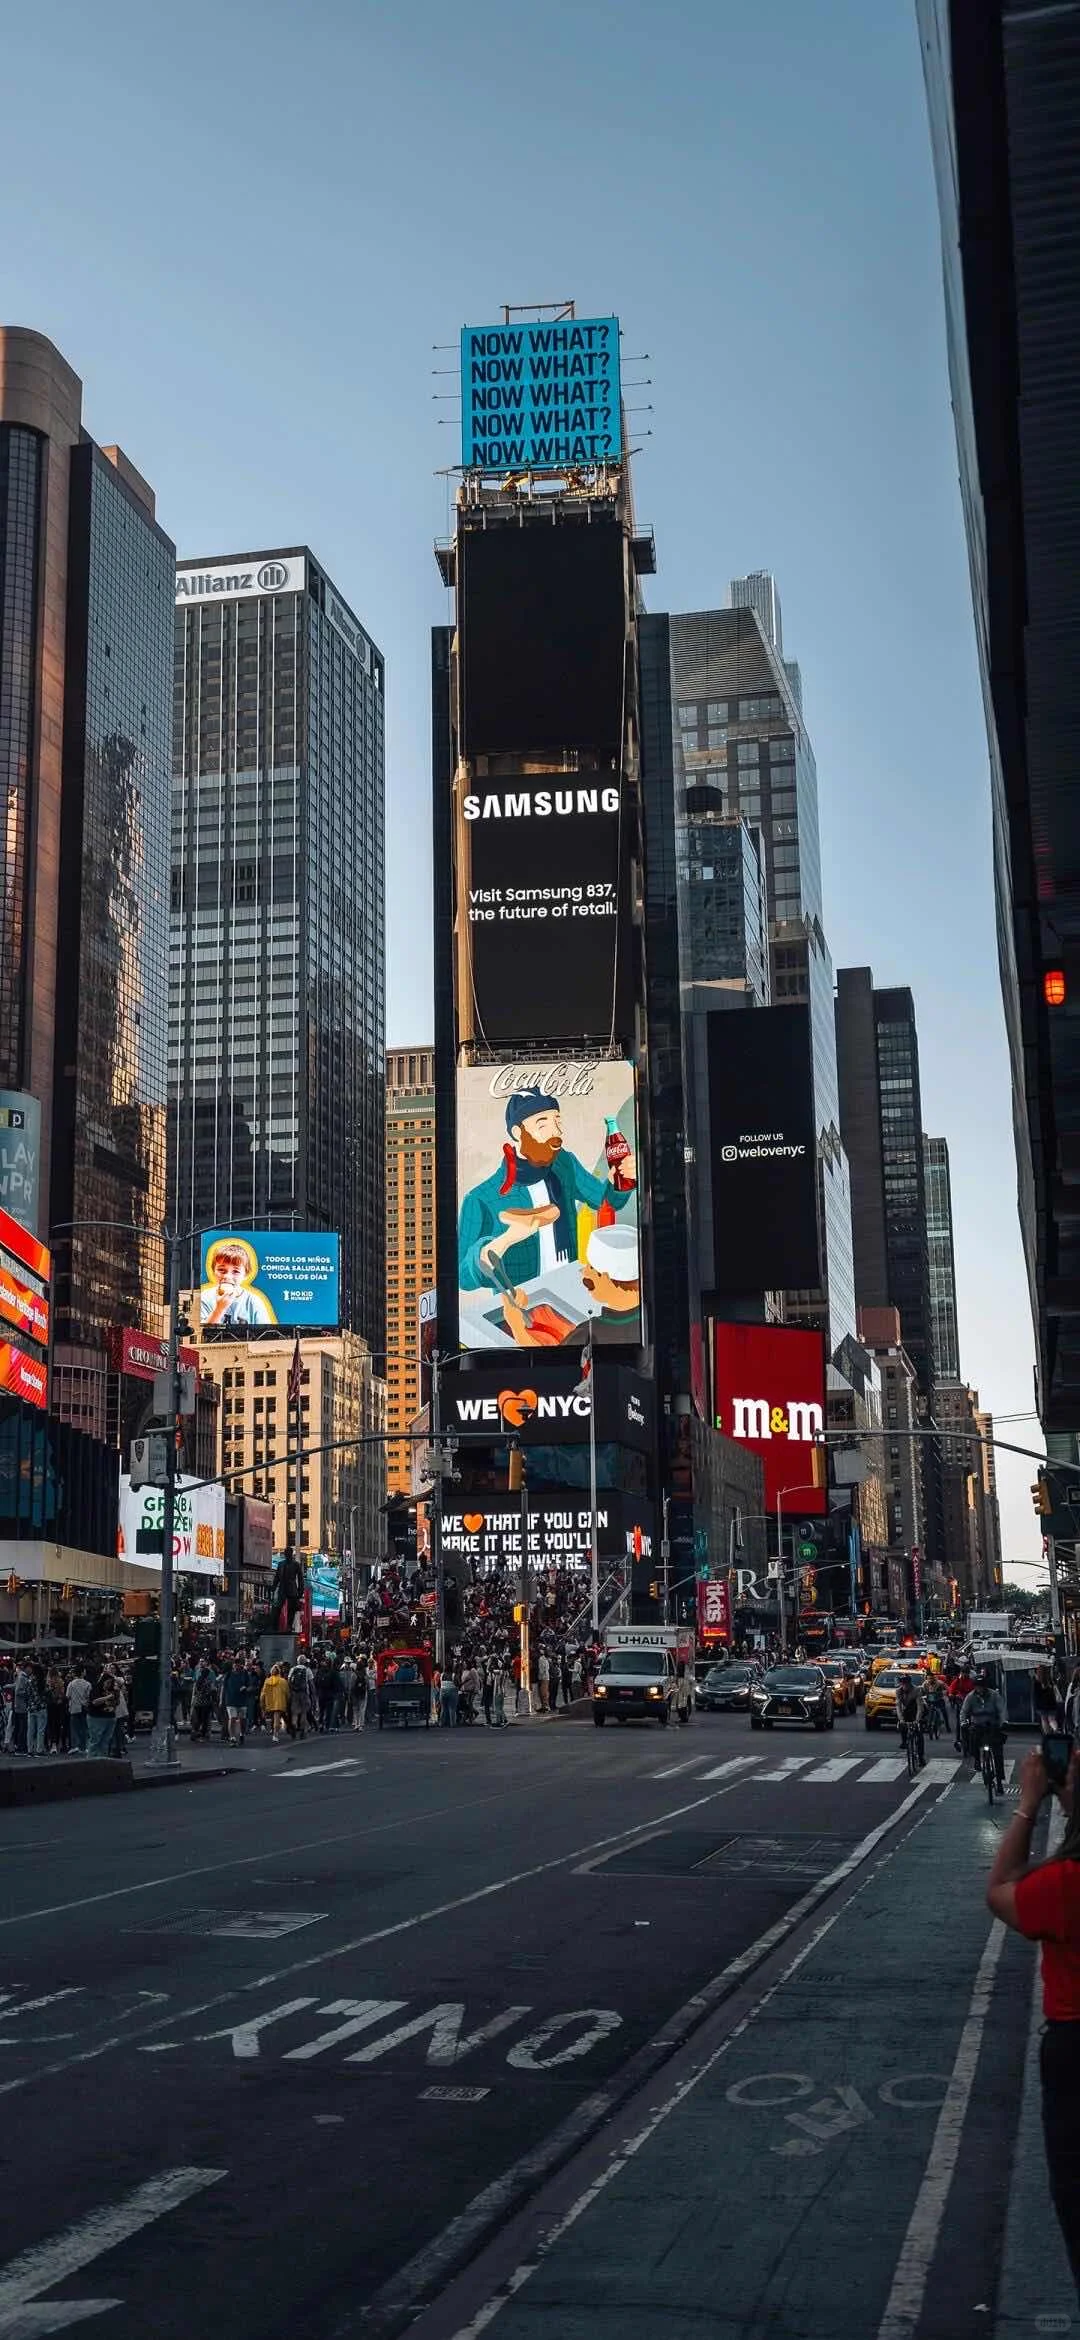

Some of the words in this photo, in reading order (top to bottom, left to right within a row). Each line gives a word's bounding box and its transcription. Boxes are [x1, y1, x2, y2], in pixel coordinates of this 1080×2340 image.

[471, 332, 523, 357] NOW
[529, 325, 609, 353] WHAT?
[471, 358, 523, 383] NOW
[529, 352, 610, 379] WHAT?
[471, 385, 524, 411] NOW
[529, 379, 611, 406] WHAT?
[471, 412, 525, 438] NOW
[530, 407, 611, 434] WHAT?
[472, 440, 525, 465] NOW
[530, 434, 612, 461] WHAT?
[176, 573, 252, 596] Allianz
[463, 788, 619, 820] SAMSUNG
[469, 889, 502, 903] Visit
[506, 887, 582, 901] Samsung
[586, 884, 616, 899] 837,
[468, 909, 495, 921] the
[499, 906, 547, 920] future
[552, 903, 568, 917] of
[572, 901, 618, 916] retail.
[740, 1134, 771, 1142] FOLLOW
[773, 1133, 784, 1141] US
[739, 1145, 806, 1158] welovenyc
[457, 1399, 498, 1420] WE
[538, 1396, 591, 1418] NYC
[733, 1398, 825, 1441] m&m
[441, 1515, 463, 1532] WE
[484, 1514, 521, 1530] THAT
[527, 1513, 539, 1530] IF
[544, 1512, 572, 1529] YOU
[441, 1535, 480, 1552] MAKE
[484, 1535, 498, 1551] IT
[544, 1532, 592, 1549] YOU'LL
[484, 1555, 498, 1572] IT
[618, 1636, 667, 1645] U-HAUL
